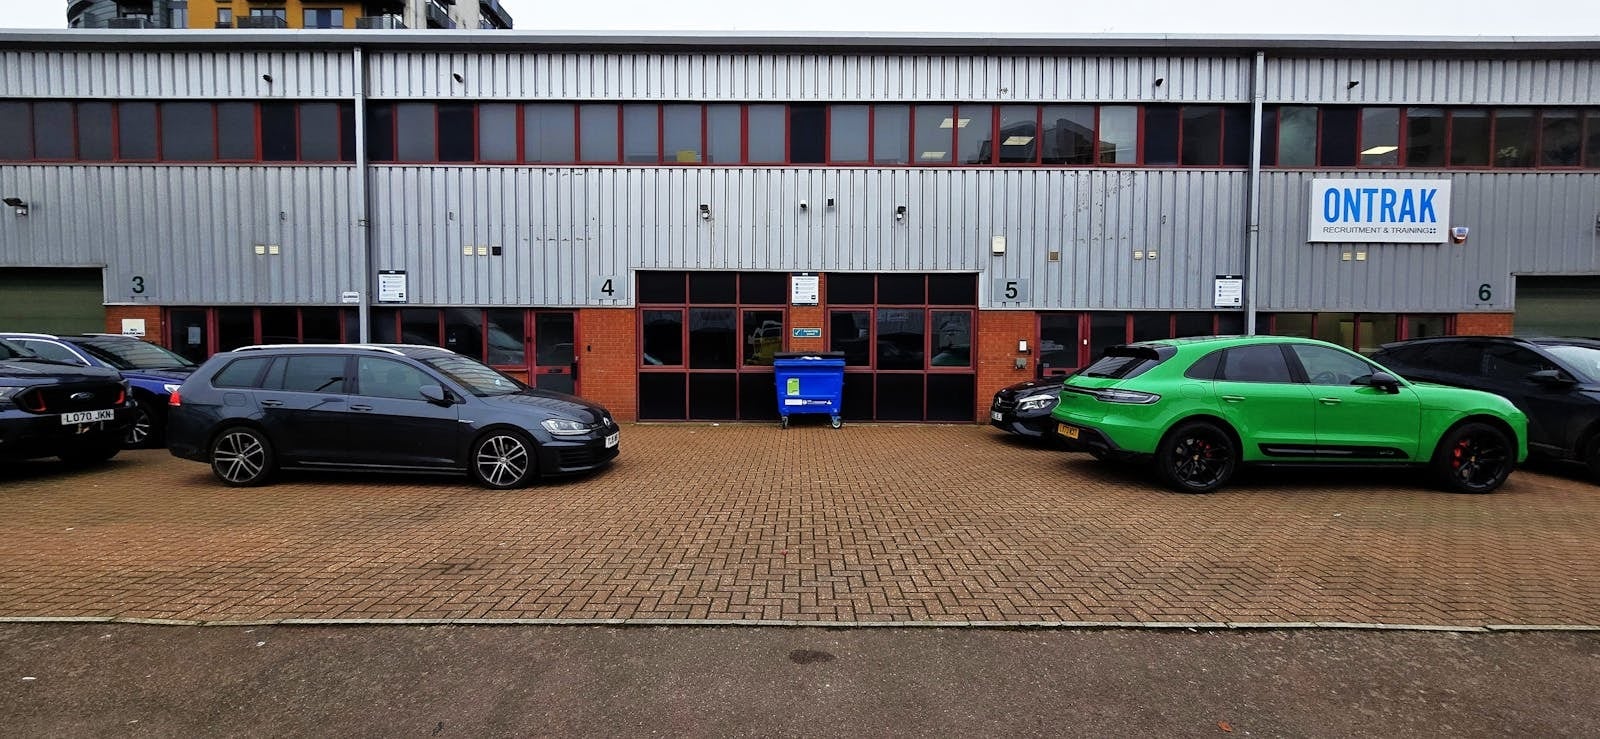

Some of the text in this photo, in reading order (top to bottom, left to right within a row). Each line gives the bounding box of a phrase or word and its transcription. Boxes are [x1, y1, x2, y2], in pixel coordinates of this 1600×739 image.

[1324, 187, 1437, 223] ONTRAK
[1323, 226, 1381, 234] RECRUITMENT
[132, 276, 145, 294] 3
[601, 279, 614, 296] 4
[1005, 282, 1018, 298] 5
[1478, 284, 1492, 301] 6
[66, 410, 111, 422] LO70 JKN
